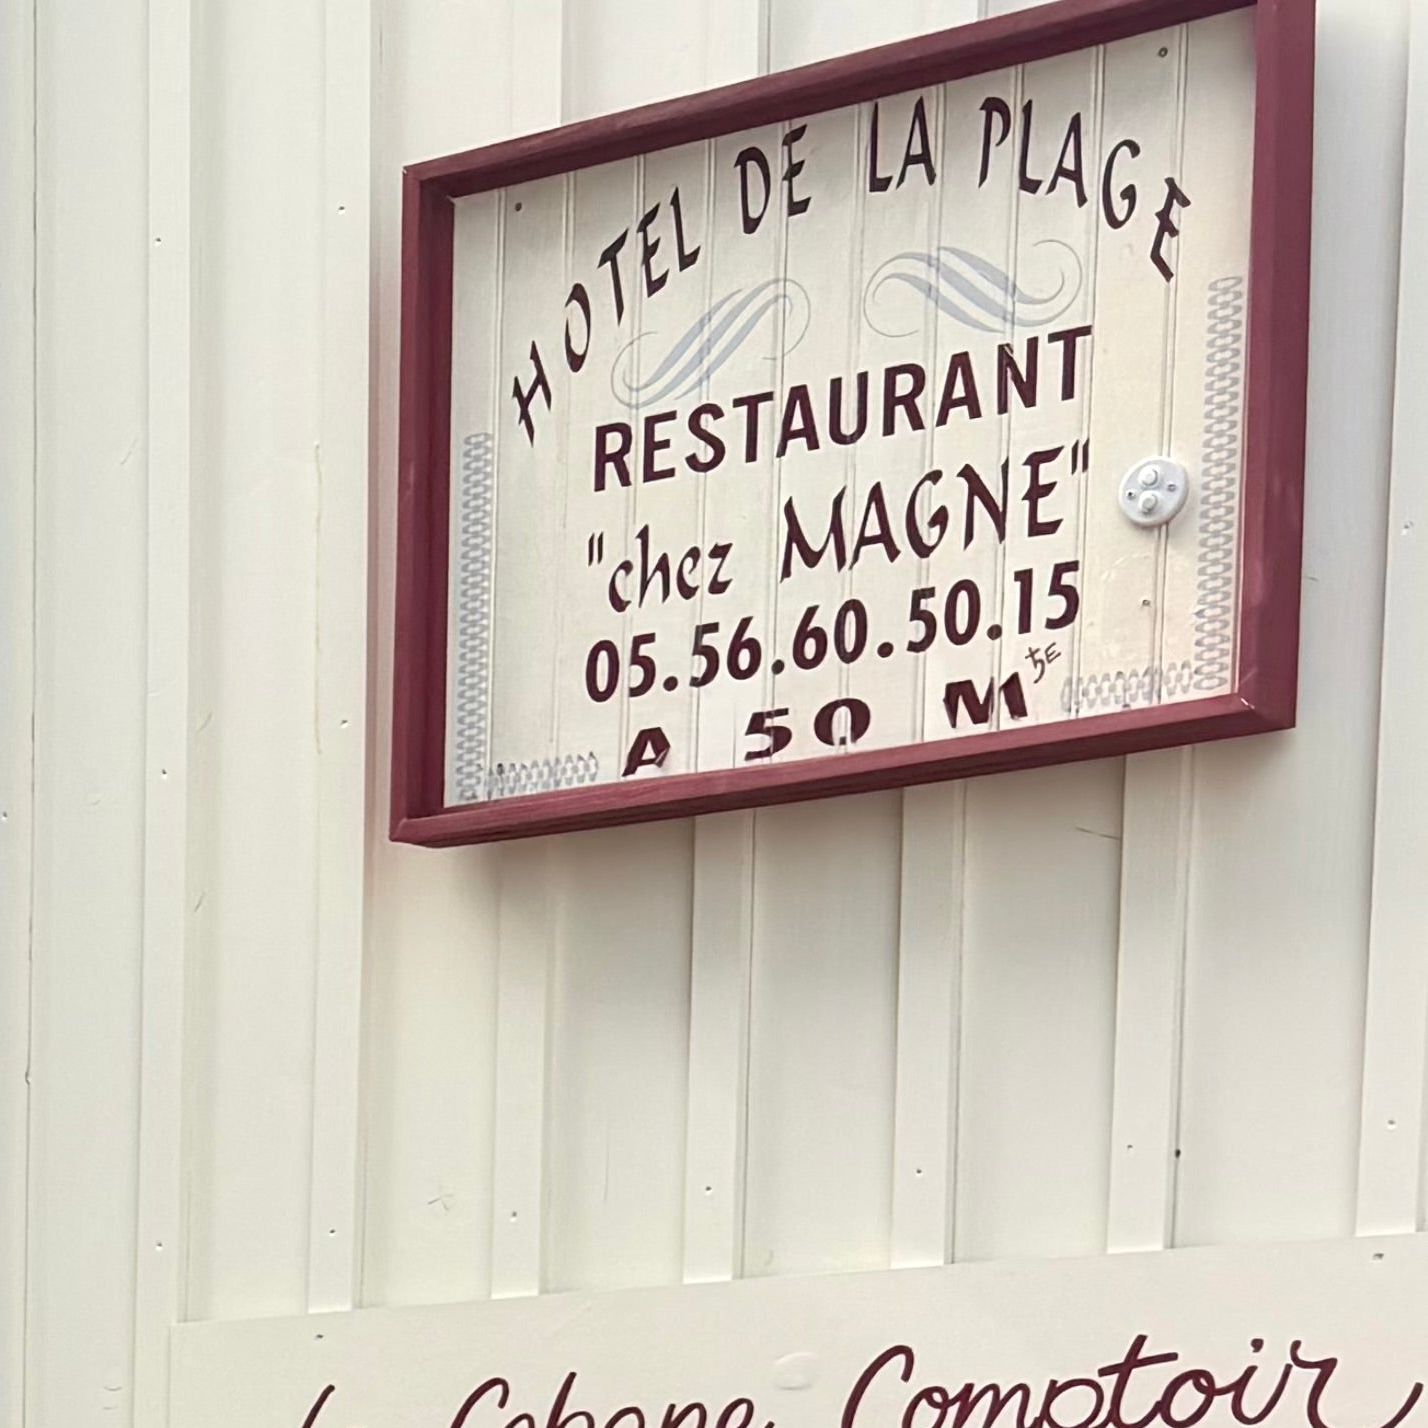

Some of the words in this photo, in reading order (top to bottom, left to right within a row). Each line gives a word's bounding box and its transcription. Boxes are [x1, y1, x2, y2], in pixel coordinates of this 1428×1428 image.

[510, 186, 701, 446] HOTEL
[732, 123, 813, 236] DE
[866, 92, 938, 194] LA
[977, 95, 1192, 283] PLAGE
[593, 325, 1093, 492] RESTAURANT
[586, 523, 734, 614] "chez
[779, 438, 1091, 584] MAGNE"
[584, 560, 1081, 704] 05.56.60.50.15
[621, 726, 671, 777] A
[743, 697, 872, 761] 50
